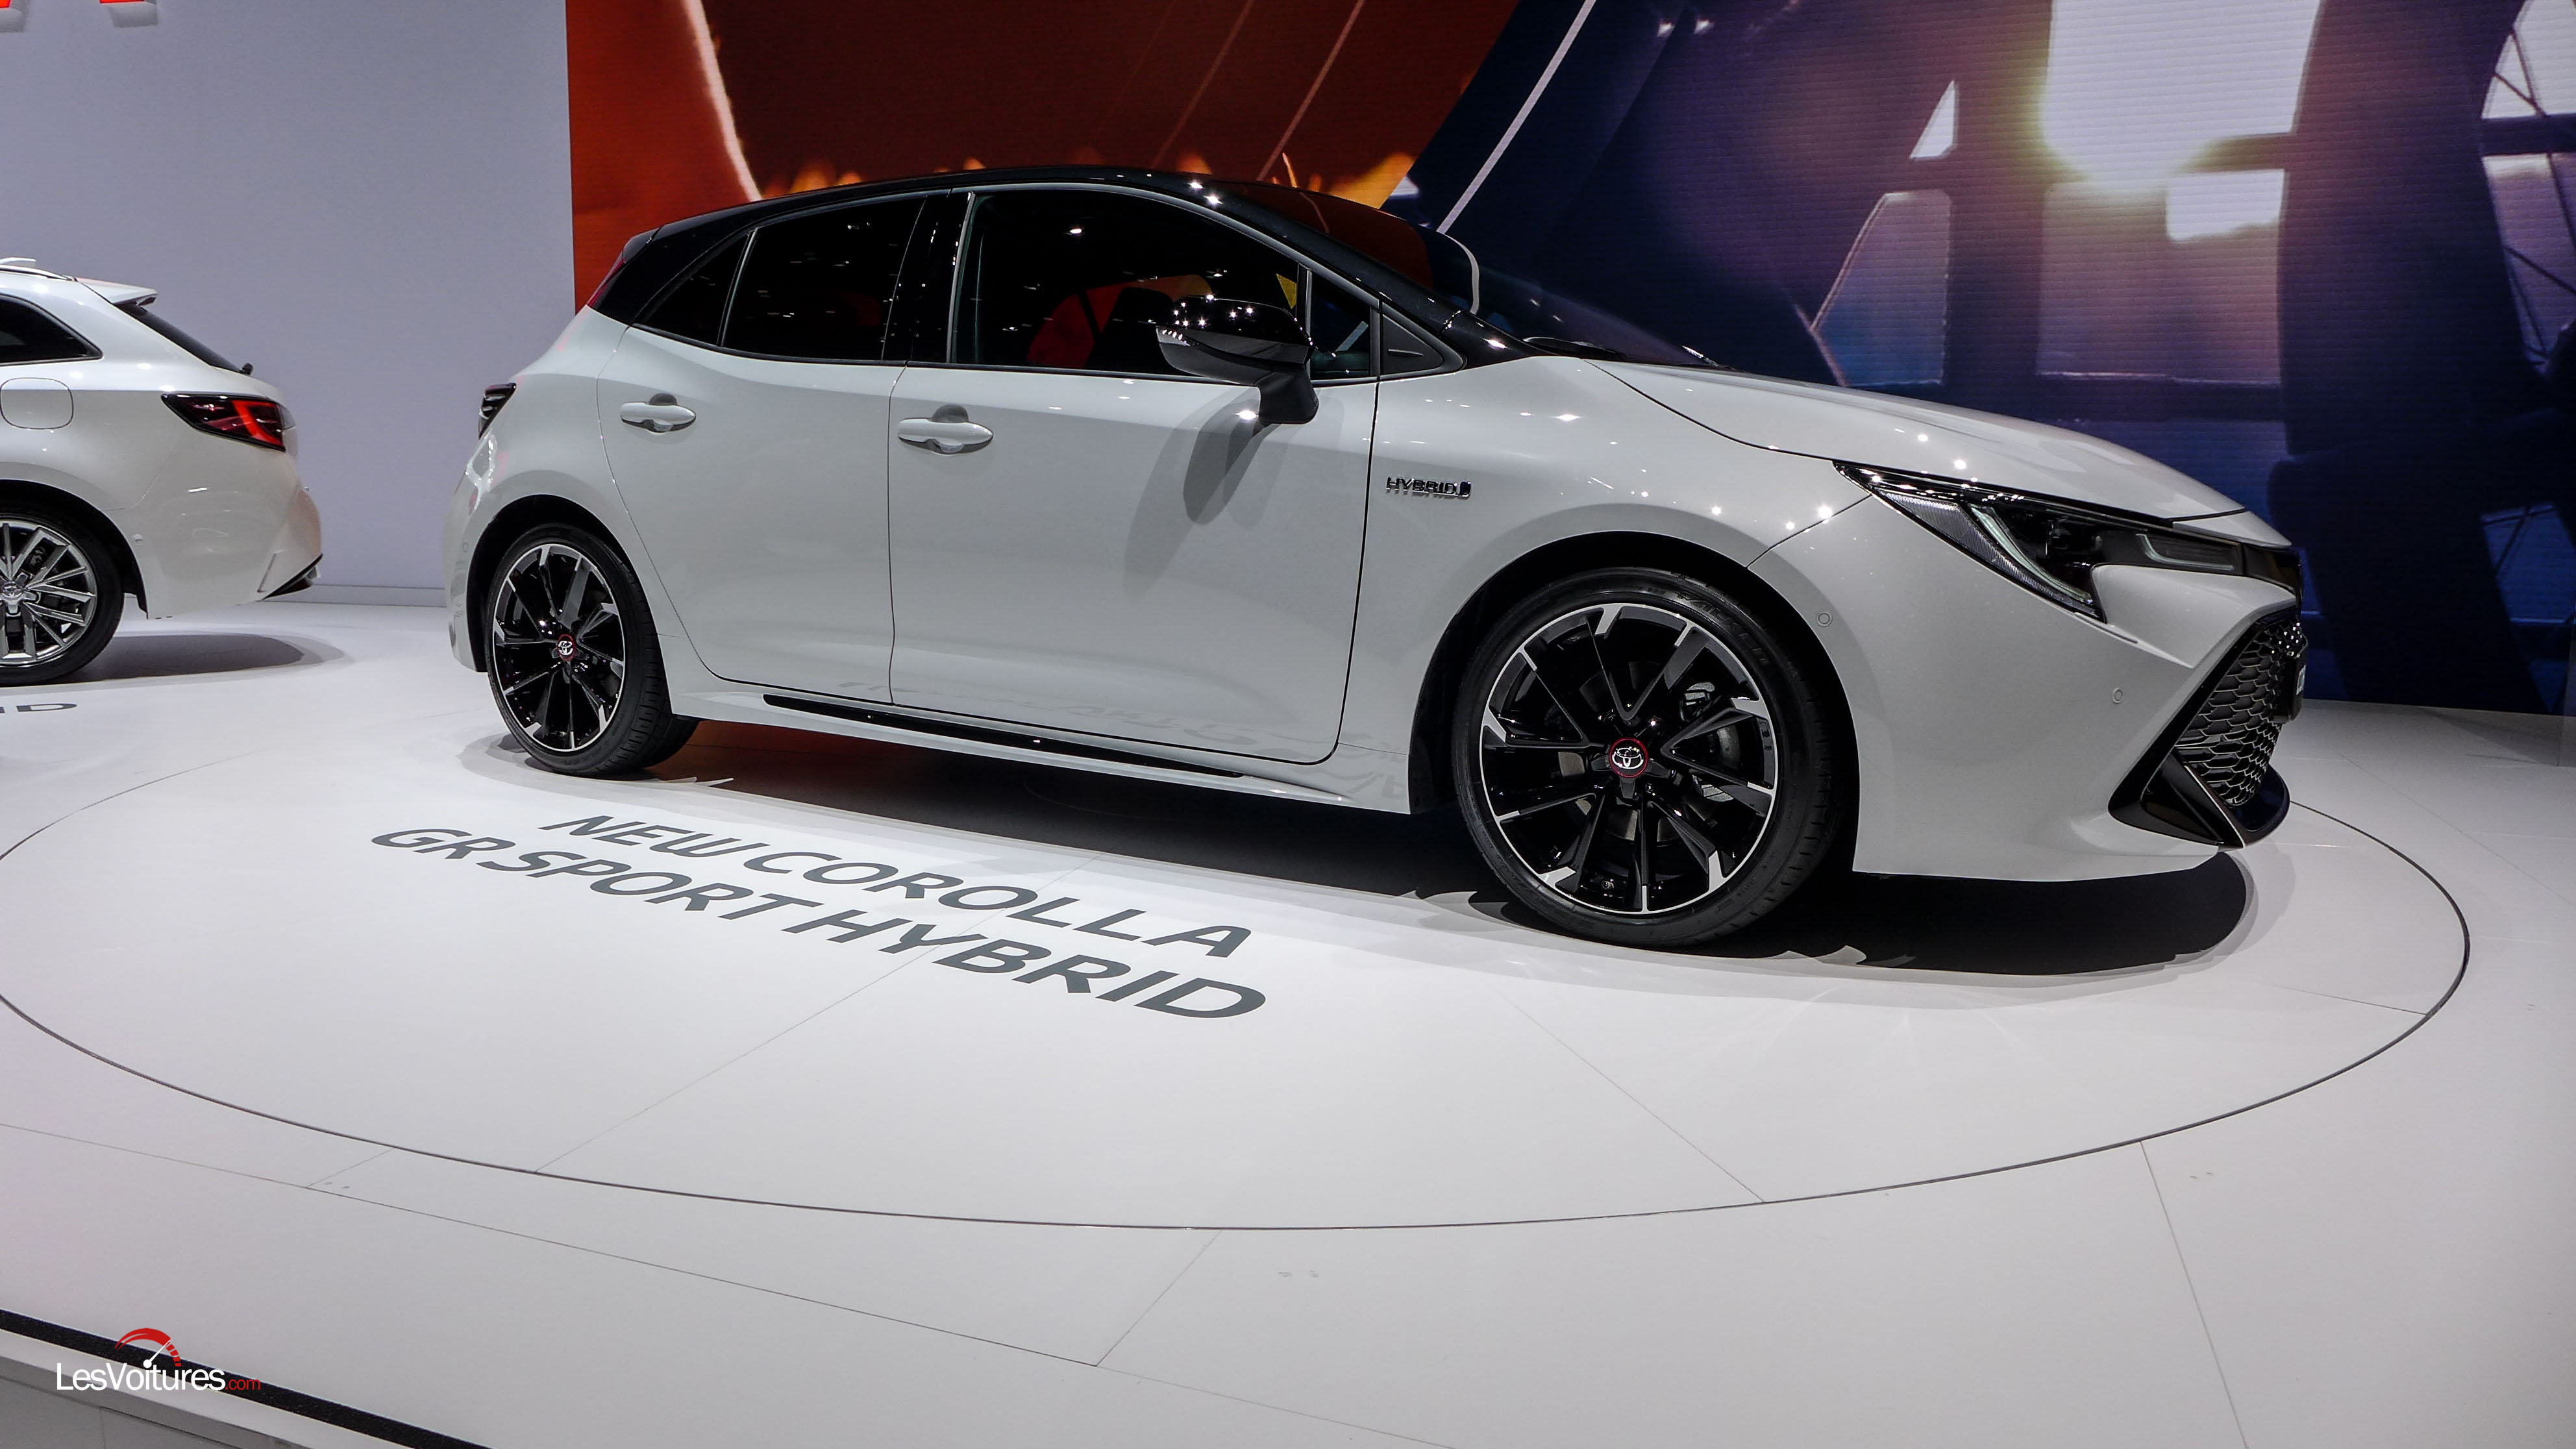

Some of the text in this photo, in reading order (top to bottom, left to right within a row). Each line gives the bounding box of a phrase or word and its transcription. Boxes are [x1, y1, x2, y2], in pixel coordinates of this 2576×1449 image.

[1386, 477, 1458, 496] HYBRID
[371, 828, 1266, 1019] GR SPORT HYBRID
[538, 815, 1252, 958] NEW COROLLA
